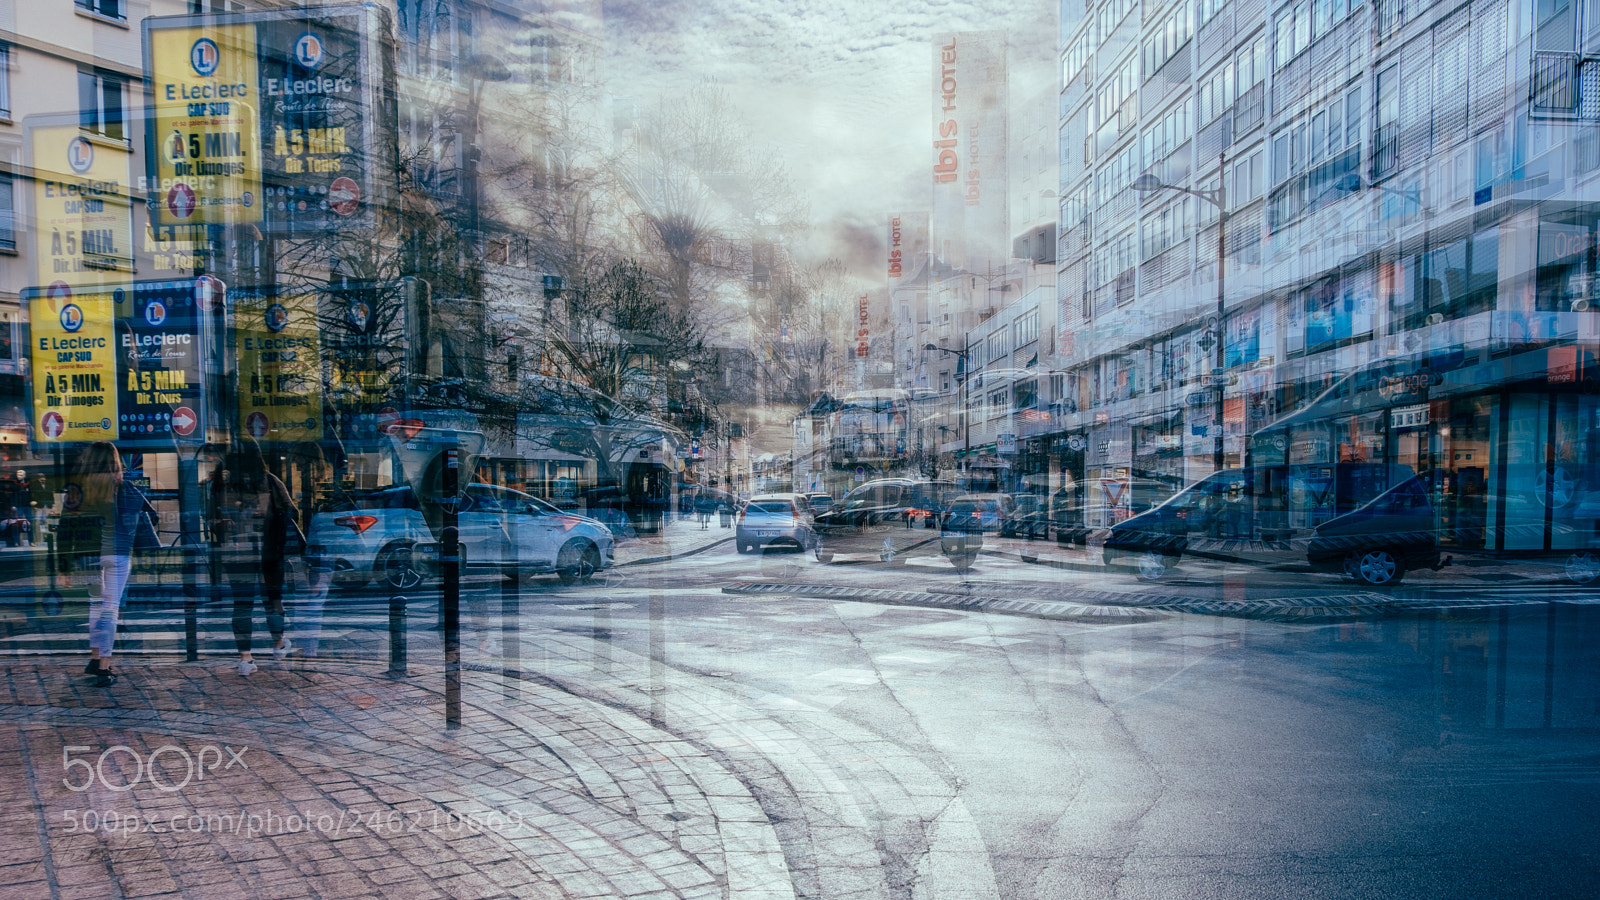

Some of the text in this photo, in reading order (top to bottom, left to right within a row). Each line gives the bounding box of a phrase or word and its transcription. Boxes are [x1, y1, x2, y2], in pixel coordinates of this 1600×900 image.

[187, 102, 229, 117] CAP SUD
[933, 37, 957, 184] ibis HOTEL
[189, 133, 200, 158] 5
[205, 132, 246, 157] MIN.
[291, 128, 304, 154] 5
[308, 127, 350, 154] MIN.
[196, 161, 245, 177] Limoges
[964, 122, 979, 206] ibis HOTEL
[66, 230, 76, 253] 5
[82, 229, 118, 254] MIN.
[159, 226, 171, 251] 5
[888, 214, 902, 278] ibis HOTEL
[855, 293, 869, 356] ibis HOTEL
[39, 336, 106, 350] E.Leclerc
[57, 350, 91, 362] CAP SUD
[45, 372, 105, 393] À 5 MIN.
[128, 368, 189, 391] À 5 MIN.
[263, 375, 273, 393] 5
[1378, 373, 1429, 396] Orange
[1547, 373, 1571, 383] orange
[47, 394, 104, 407] Dir. Limoges
[136, 392, 182, 404] Dir. Tours
